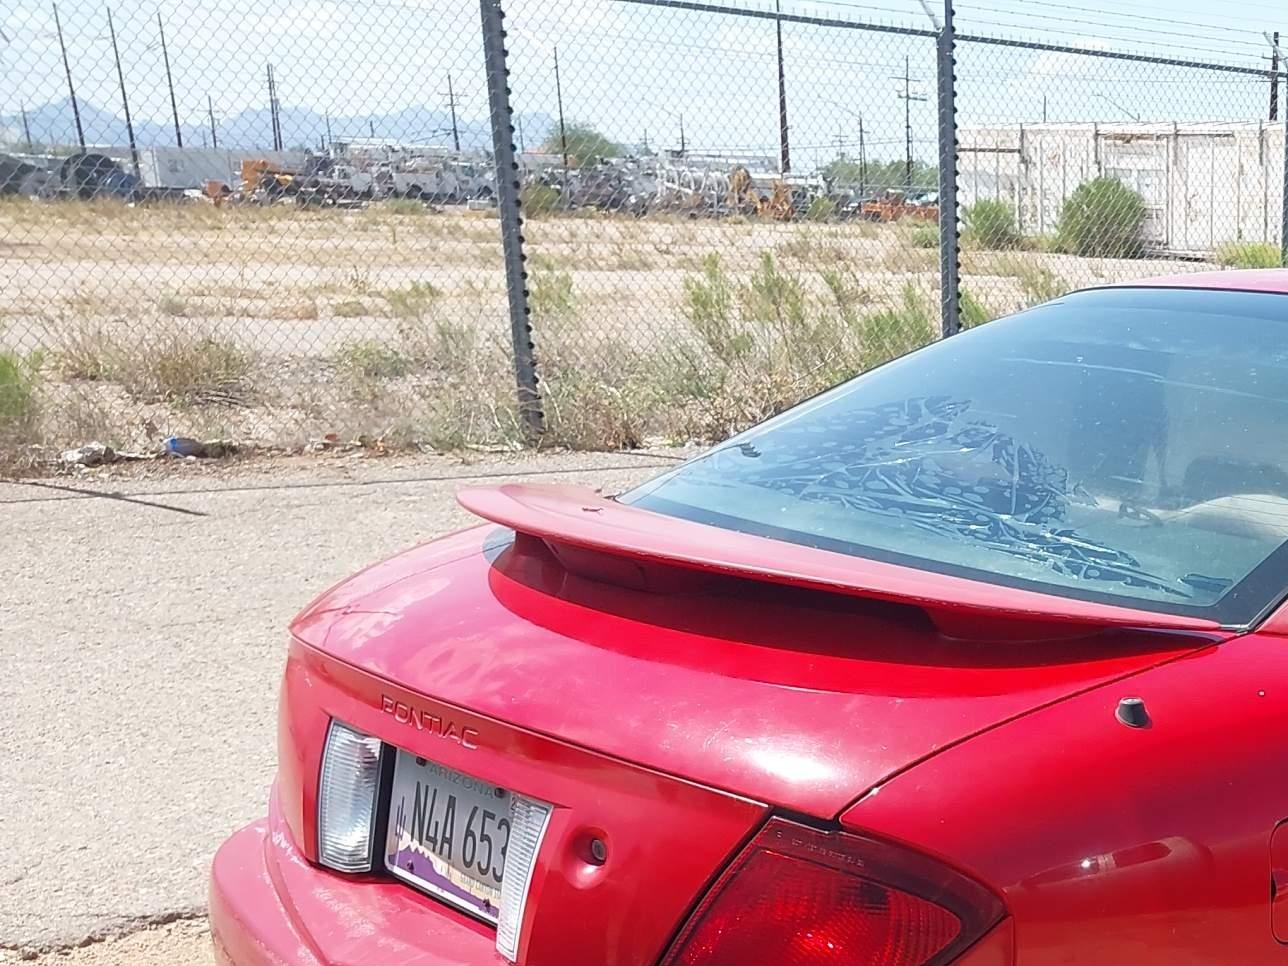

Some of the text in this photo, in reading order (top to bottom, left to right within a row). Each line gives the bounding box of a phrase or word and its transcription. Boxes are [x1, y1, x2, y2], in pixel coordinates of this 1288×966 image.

[381, 694, 480, 750] PONTIAC
[429, 764, 495, 800] ARIZONA
[409, 780, 457, 861] N4A
[461, 805, 512, 884] 653
